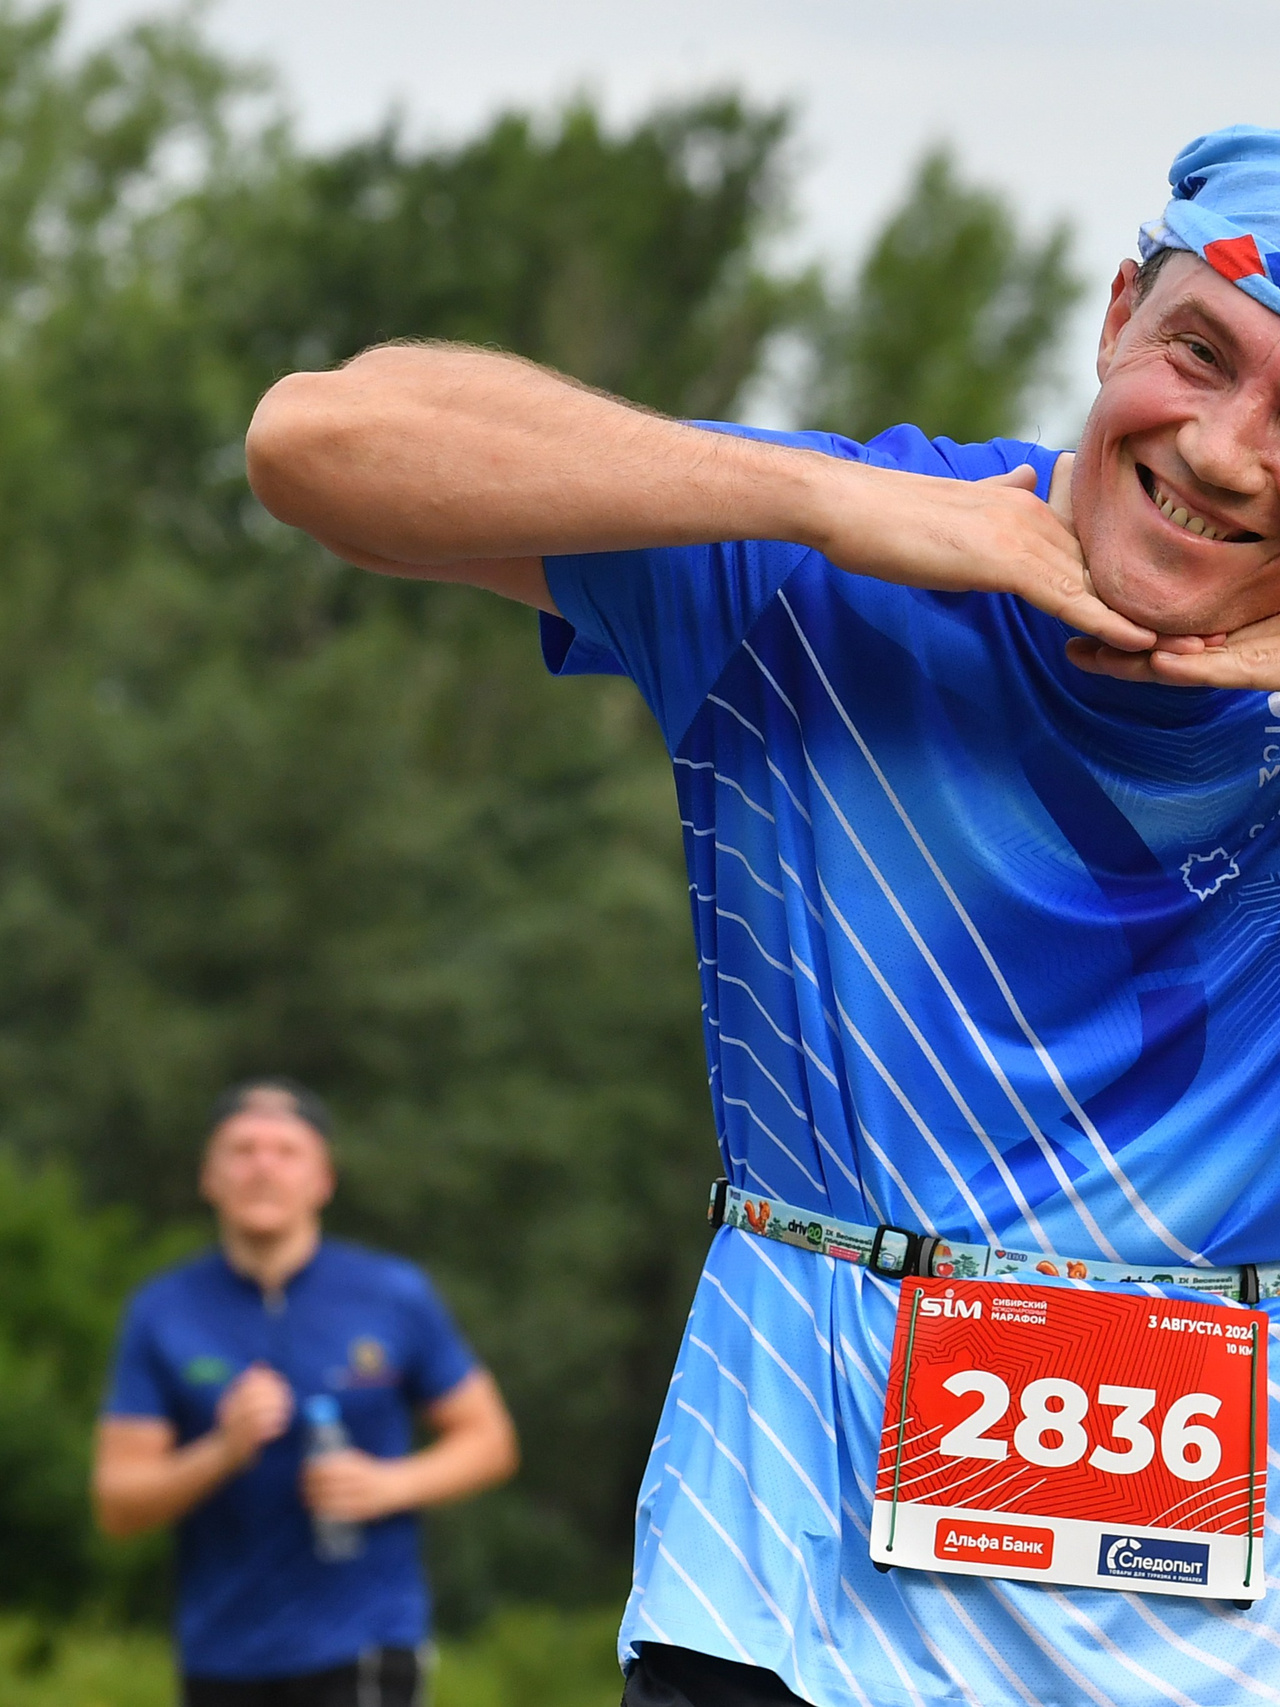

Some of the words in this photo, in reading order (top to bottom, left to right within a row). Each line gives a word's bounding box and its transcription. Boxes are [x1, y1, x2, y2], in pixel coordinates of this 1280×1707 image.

[992, 1298, 1048, 1310] СИБИРСКИЙ
[991, 1312, 1046, 1325] МАРАФОН
[1148, 1315, 1157, 1328] 3
[1160, 1317, 1222, 1336] АВГУСТА
[1226, 1343, 1237, 1353] 10
[939, 1369, 1222, 1482] 2836
[943, 1530, 999, 1553] Альфа
[1002, 1536, 1044, 1554] Банк
[1118, 1551, 1203, 1574] Следопыт
[1147, 1572, 1171, 1580] ТУРИЗМА
